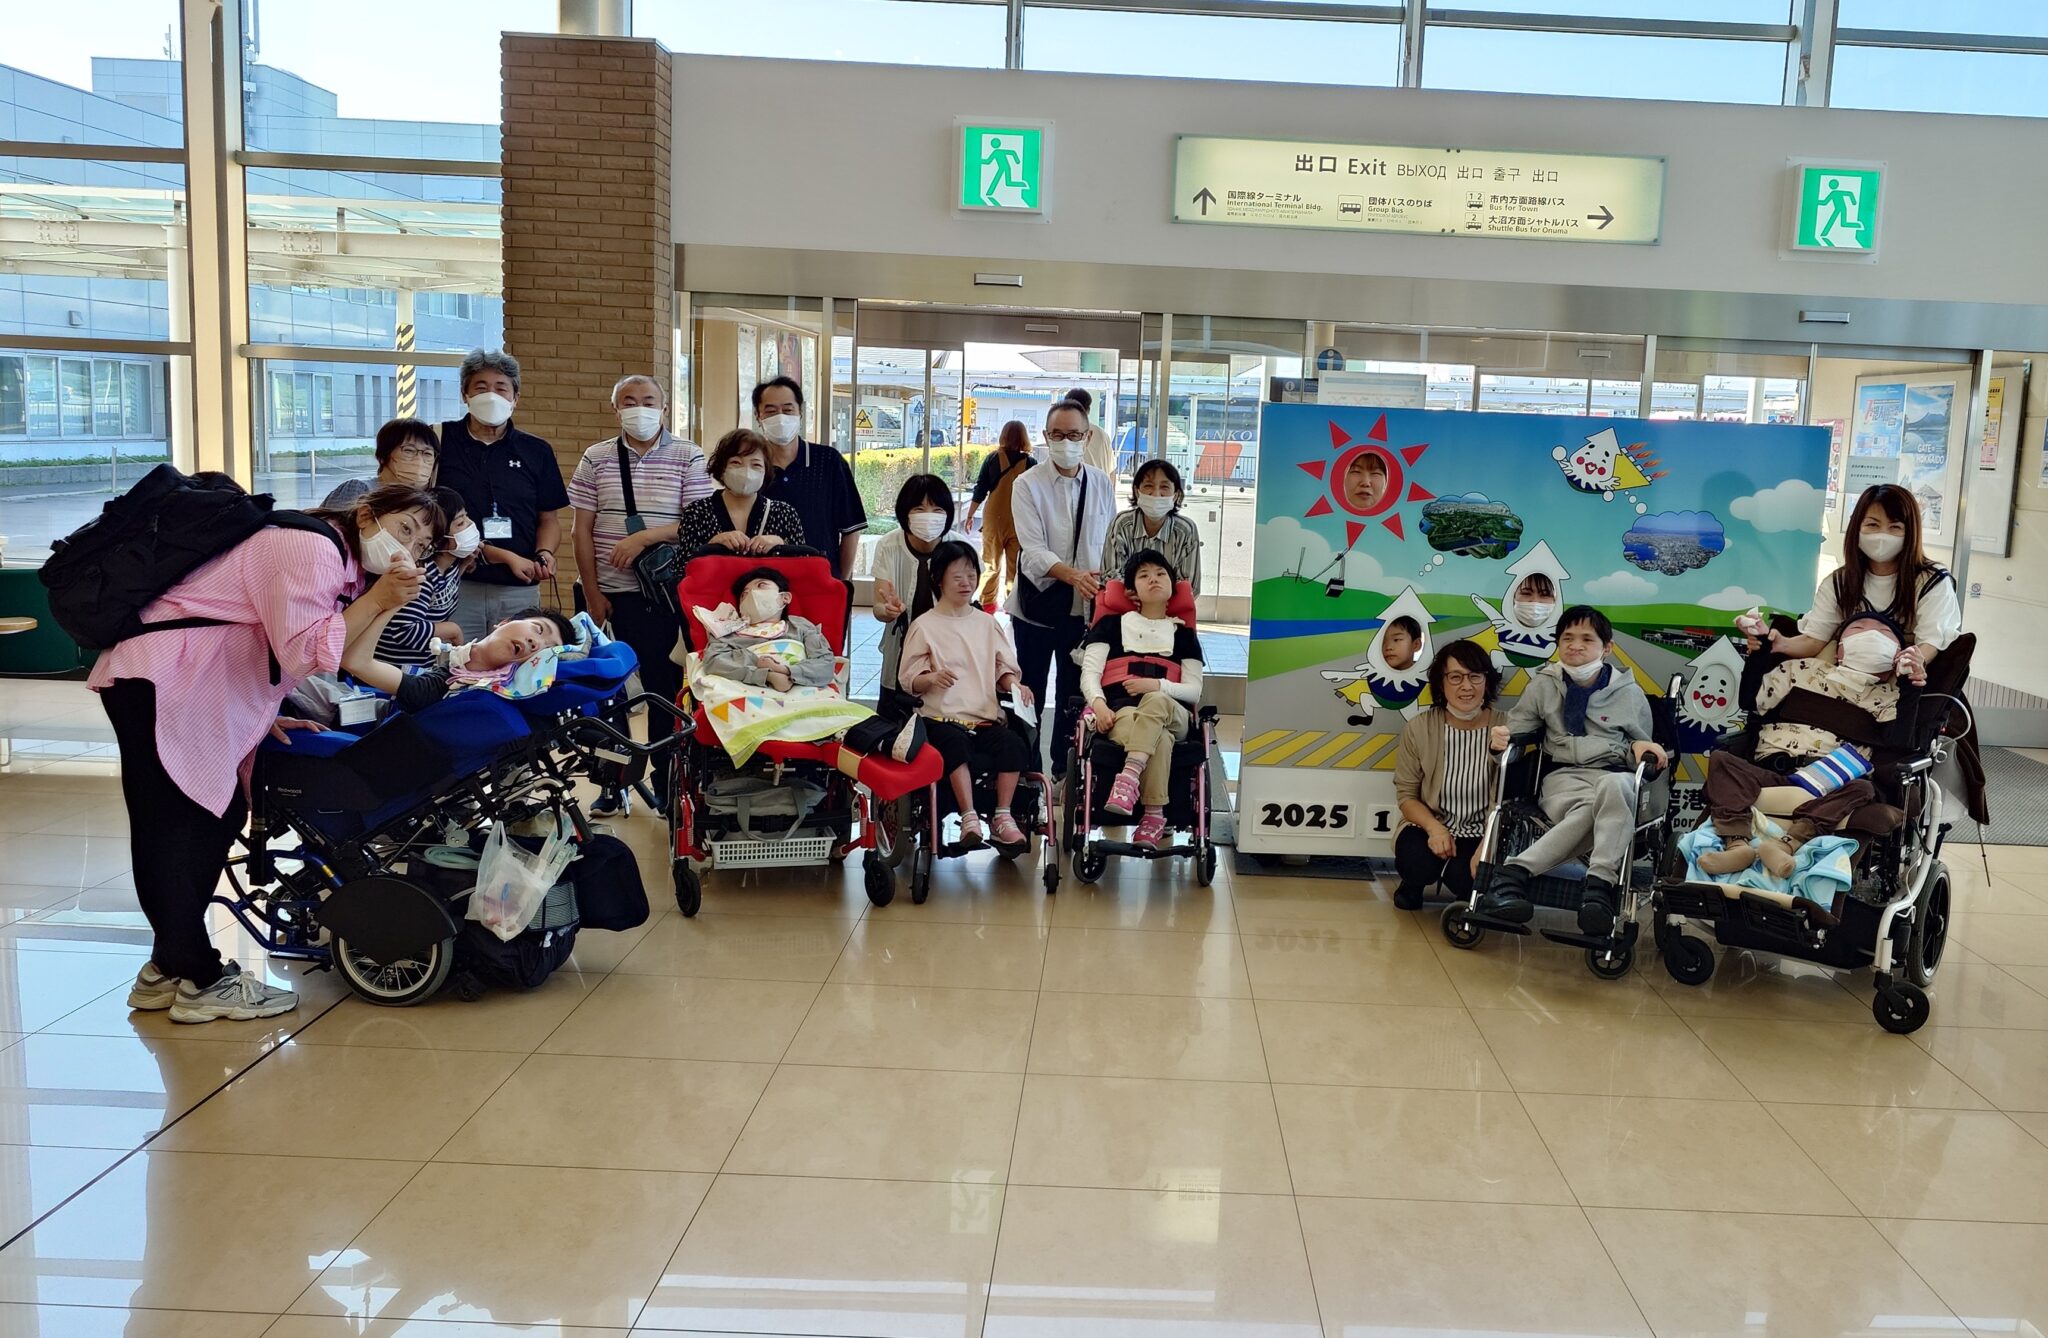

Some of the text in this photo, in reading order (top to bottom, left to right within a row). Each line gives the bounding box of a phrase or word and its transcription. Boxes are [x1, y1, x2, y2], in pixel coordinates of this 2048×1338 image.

[1295, 154, 1559, 183] 出口 Exit ВЫХОД 出口 출구 出口
[1227, 190, 1302, 202] 国際線ターミナル
[1368, 196, 1433, 208] 団体バスのりば
[1490, 195, 1566, 206] 市内方面路線バス
[1227, 200, 1272, 208] International
[1305, 203, 1323, 211] Bldg.
[1368, 206, 1389, 214] Group
[1488, 215, 1579, 228] 大沼方面シャトルバス
[1488, 224, 1514, 232] Shuttle
[1515, 225, 1528, 233] Bus
[1198, 429, 1253, 441] ANKO
[1261, 803, 1391, 832] 2025 1
